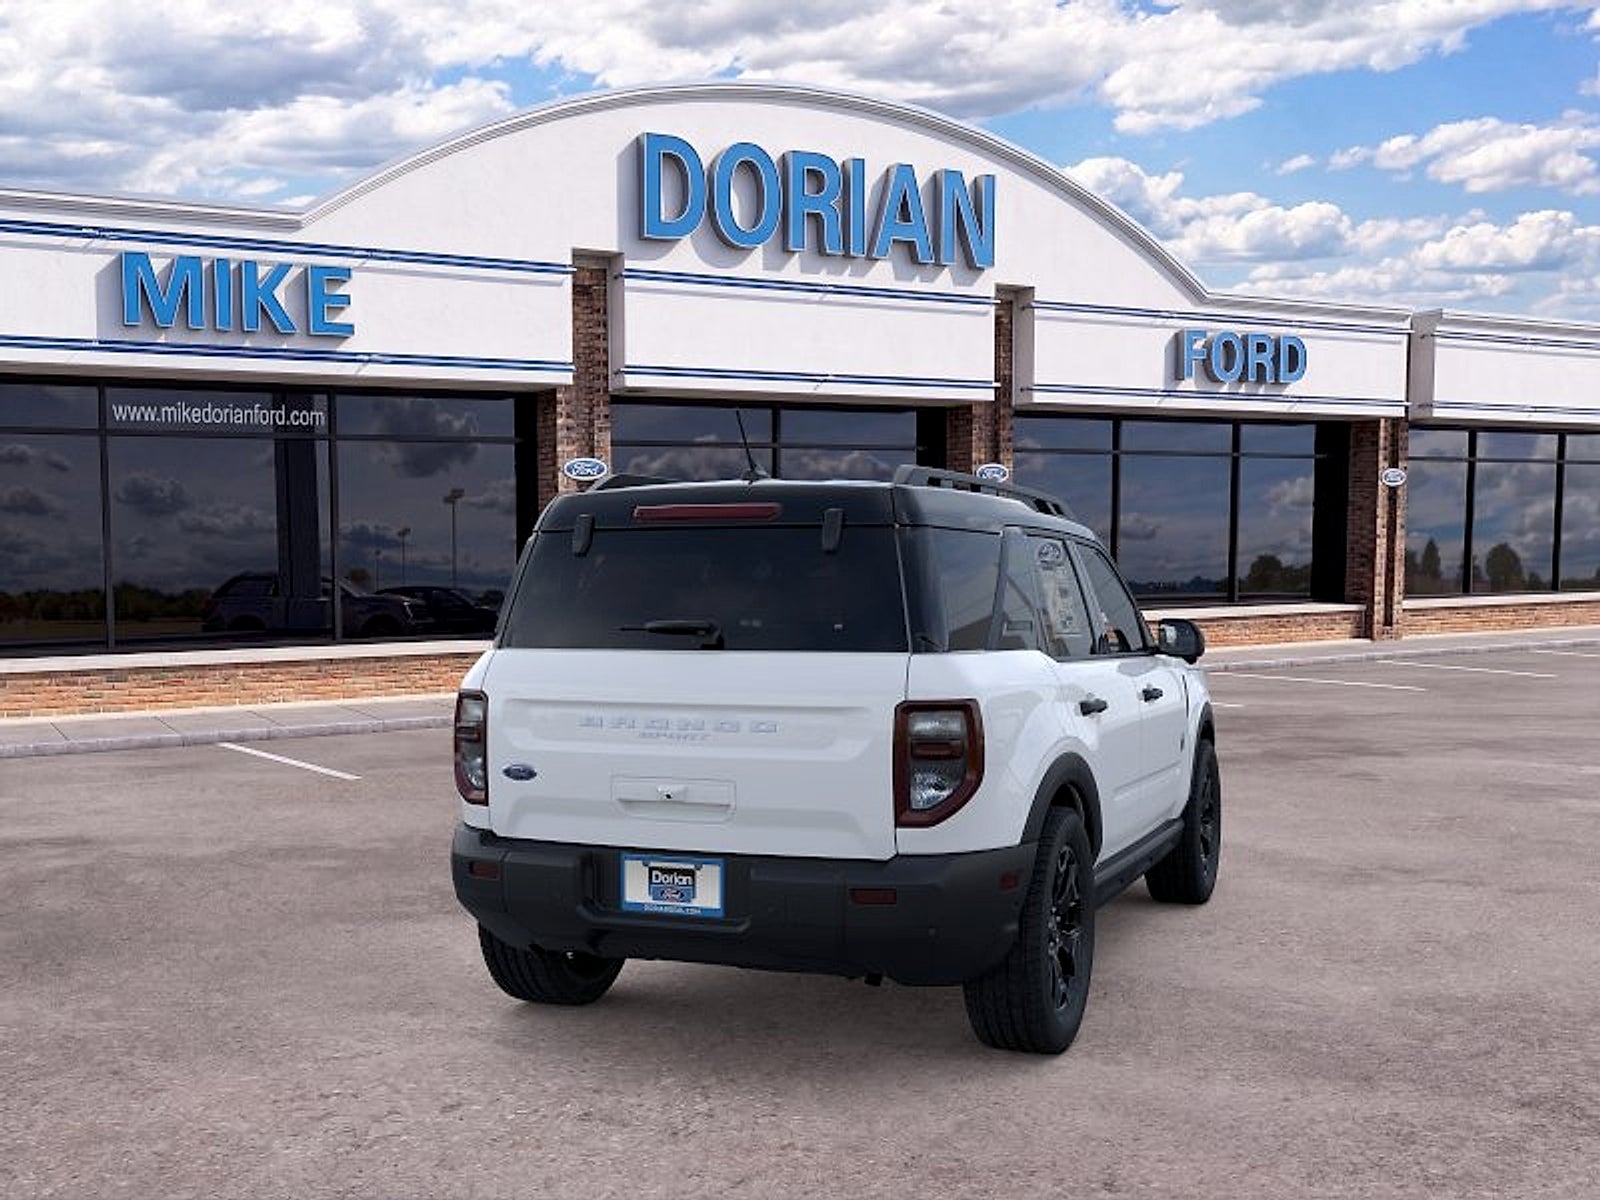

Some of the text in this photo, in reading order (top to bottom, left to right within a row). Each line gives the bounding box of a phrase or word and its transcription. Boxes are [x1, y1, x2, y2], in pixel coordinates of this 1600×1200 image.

[640, 132, 996, 270] DORIAN
[121, 251, 355, 338] MIKE
[1175, 328, 1308, 384] FORD
[111, 402, 326, 426] www.mikedorianford.com
[651, 869, 693, 886] Dorian
